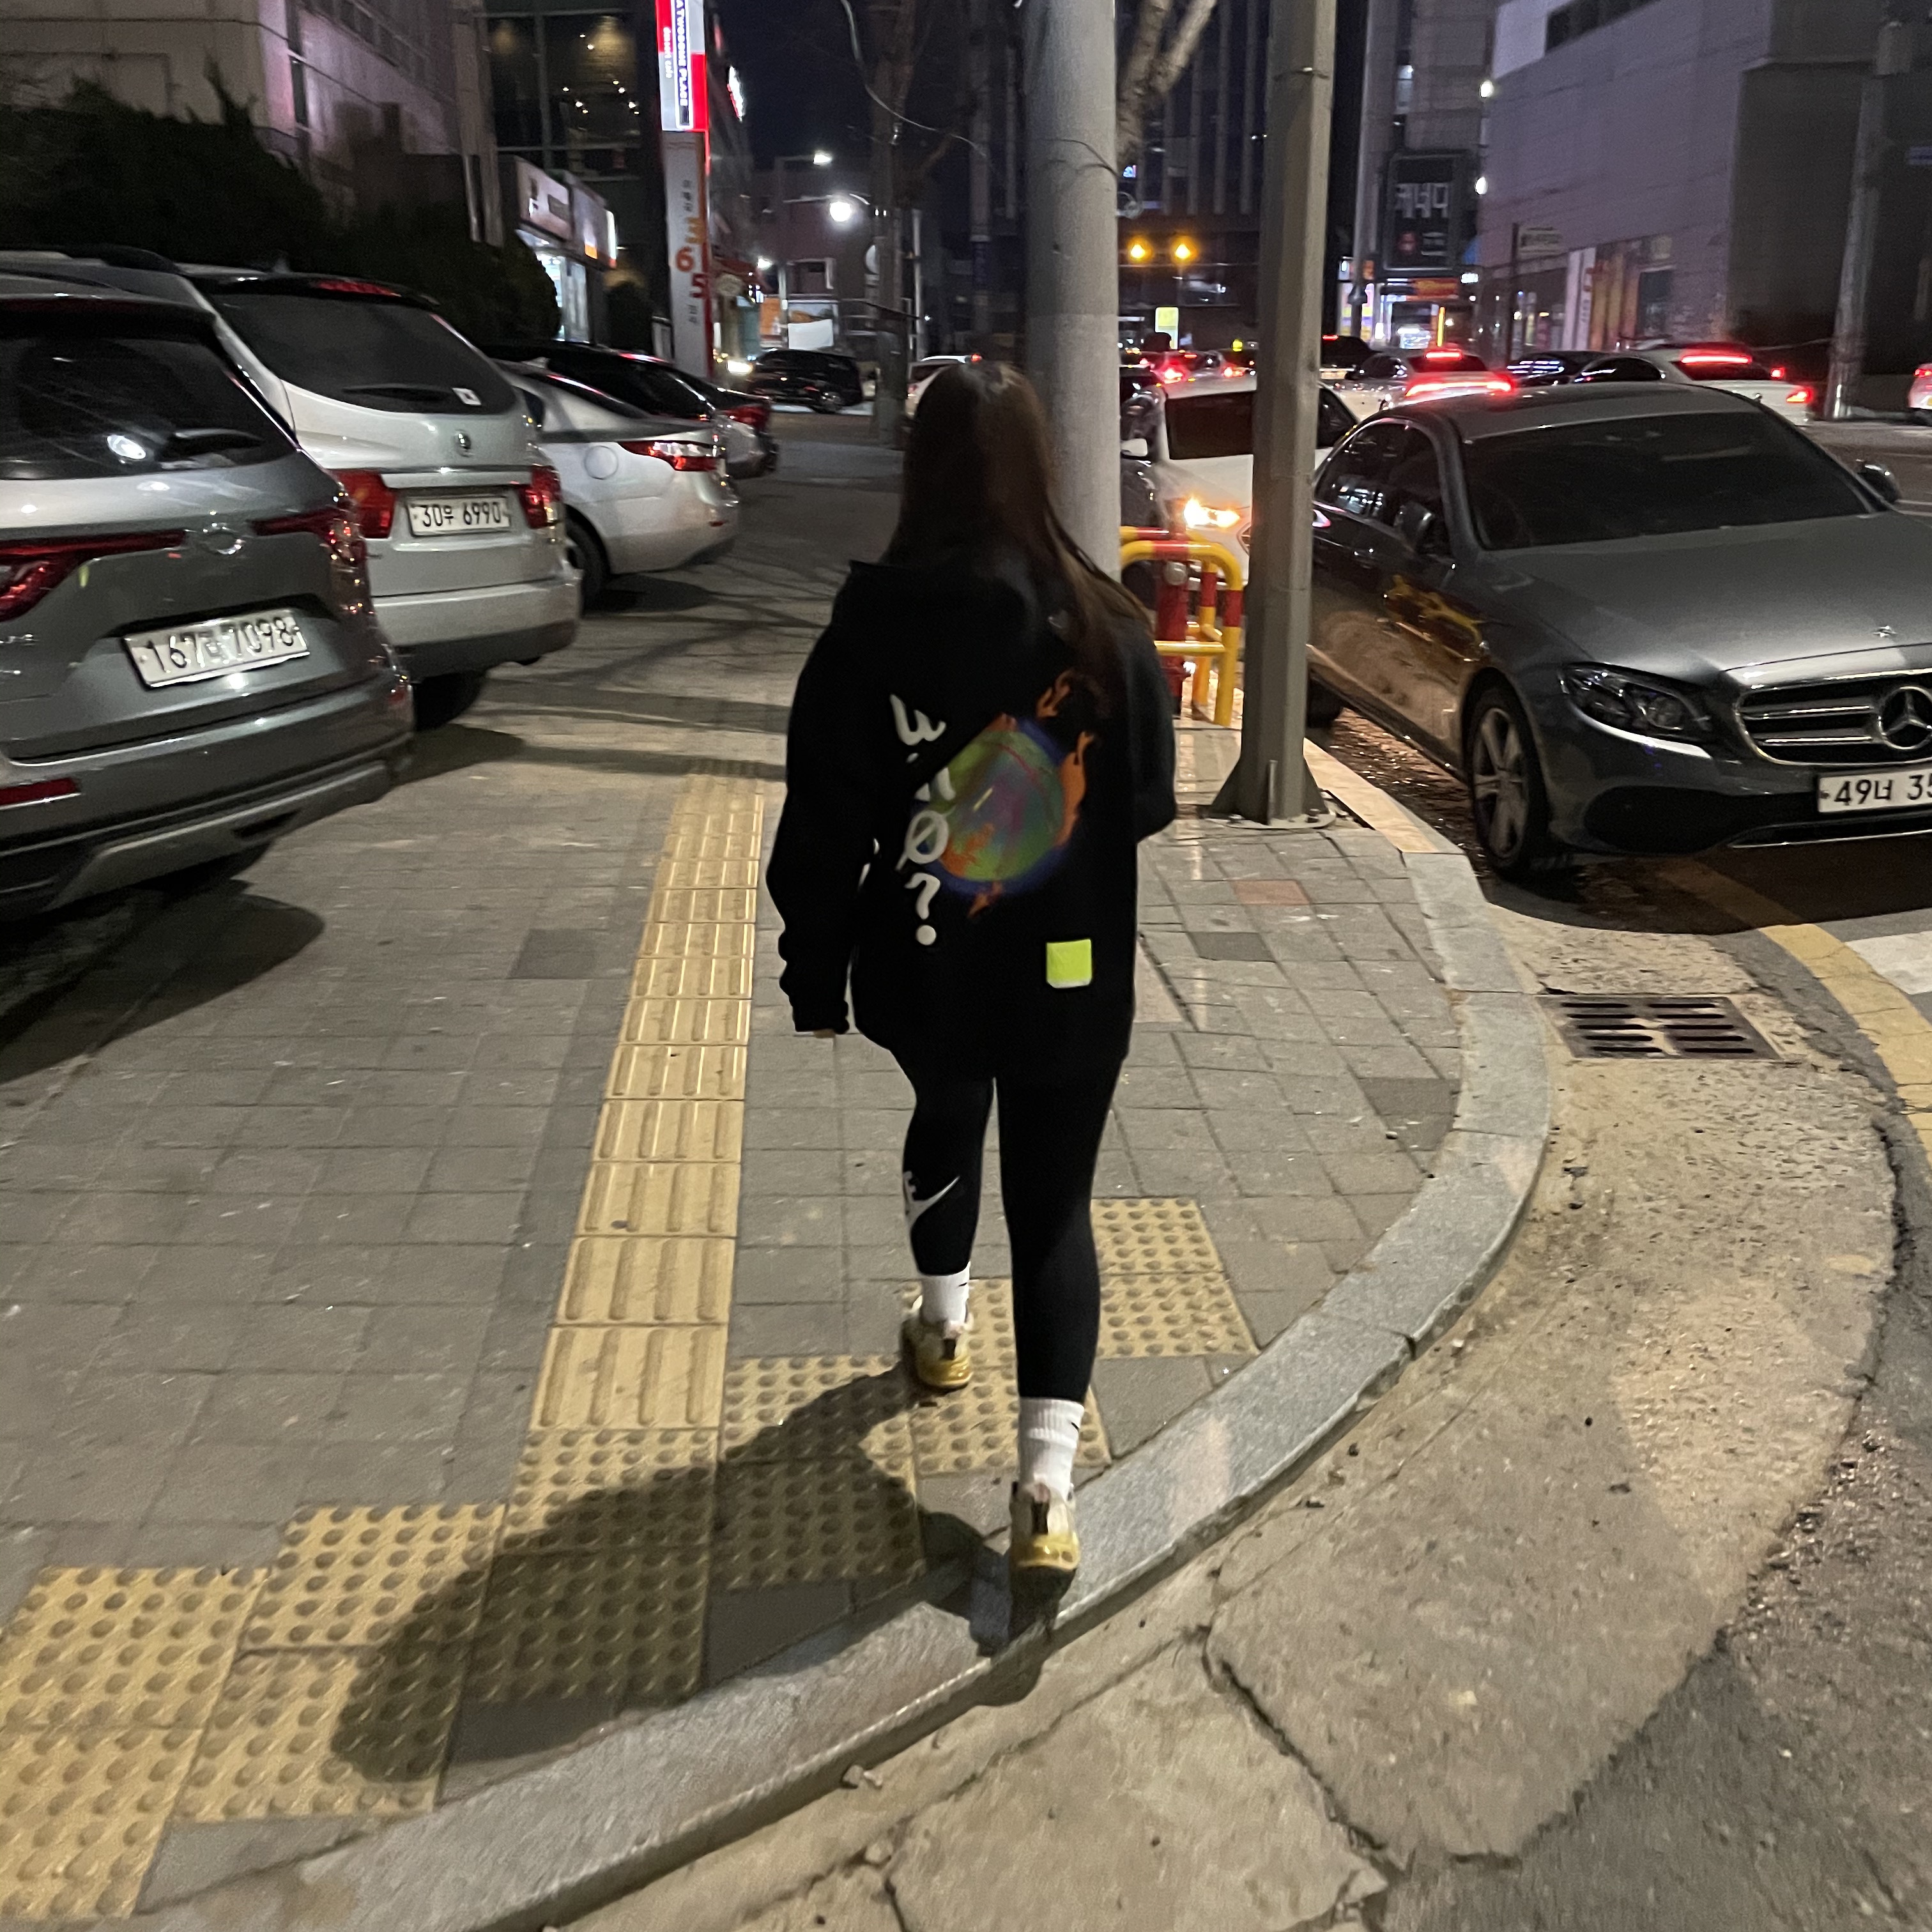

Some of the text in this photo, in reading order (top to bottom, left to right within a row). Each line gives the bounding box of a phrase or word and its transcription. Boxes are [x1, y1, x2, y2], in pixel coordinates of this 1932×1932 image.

[679, 68, 688, 106] PLACE
[420, 502, 502, 527] 30우 6990
[221, 616, 294, 658] 7098
[1834, 779, 1894, 806] 49너
